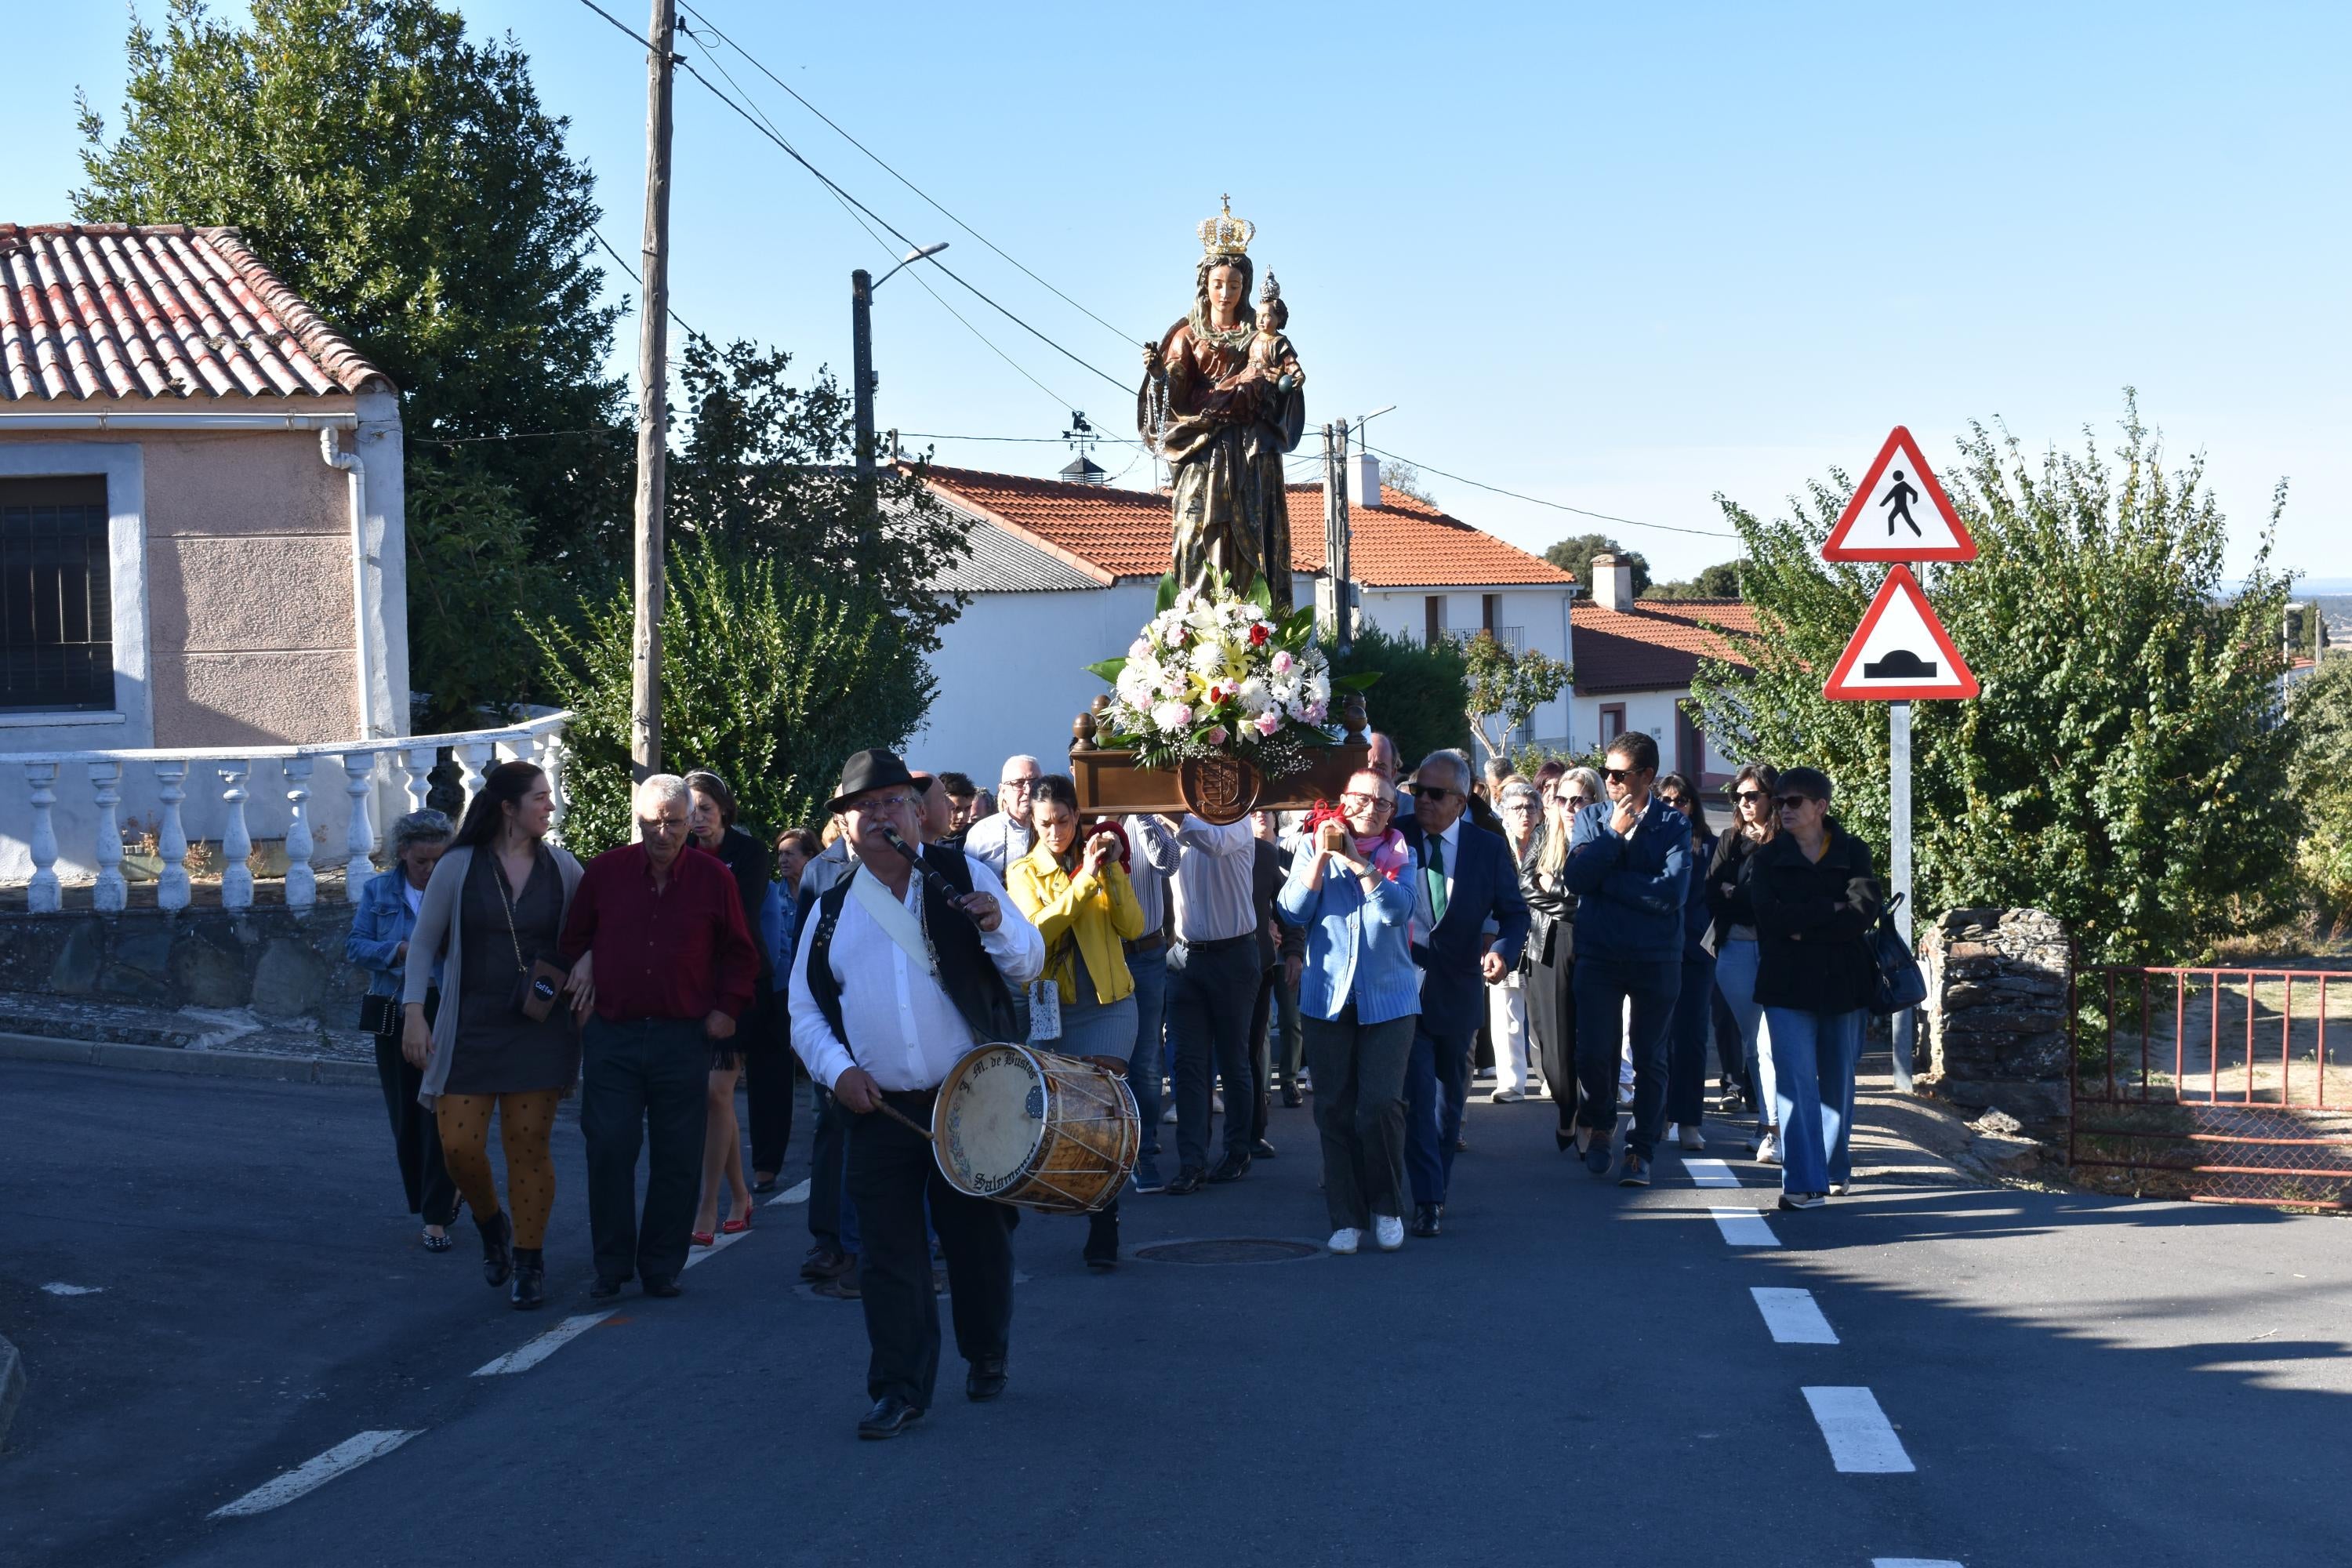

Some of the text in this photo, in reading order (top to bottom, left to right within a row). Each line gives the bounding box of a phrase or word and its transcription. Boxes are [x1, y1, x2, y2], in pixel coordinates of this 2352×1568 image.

[535, 981, 554, 996] Coffee
[973, 1059, 988, 1079] M.
[990, 1056, 1001, 1067] de
[1004, 1051, 1037, 1080] Bustos
